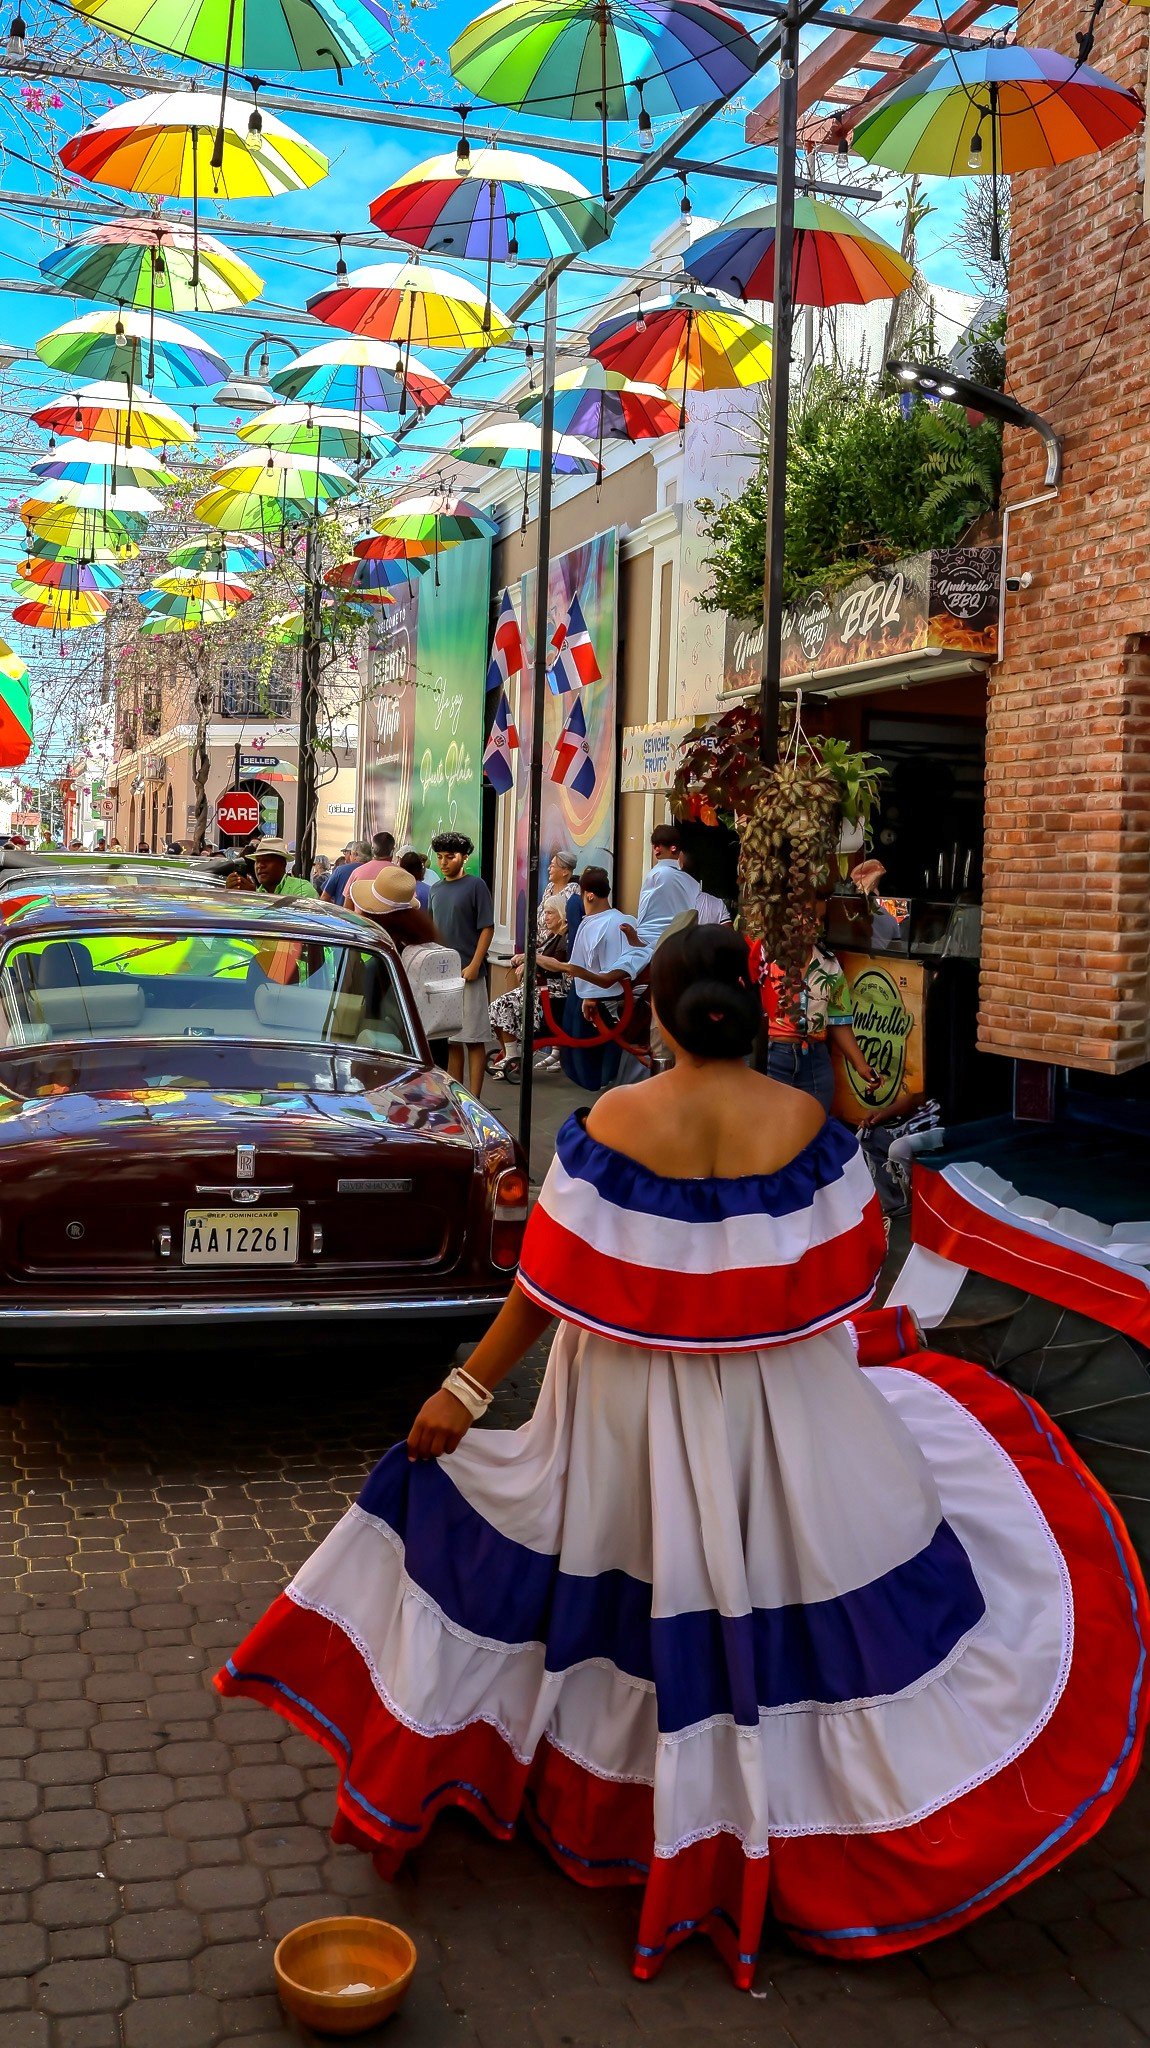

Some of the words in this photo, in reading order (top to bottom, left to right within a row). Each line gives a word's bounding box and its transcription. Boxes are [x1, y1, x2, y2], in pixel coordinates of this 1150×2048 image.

[937, 579, 993, 595] Umbrella
[839, 572, 904, 644] BBQ
[948, 592, 981, 608] BBQ
[803, 622, 826, 648] BBQ
[643, 735, 671, 754] CEVICHE
[243, 757, 276, 766] BELLER
[644, 755, 669, 774] FRUITS
[217, 806, 258, 822] PARE
[190, 1227, 290, 1252] AA12261
